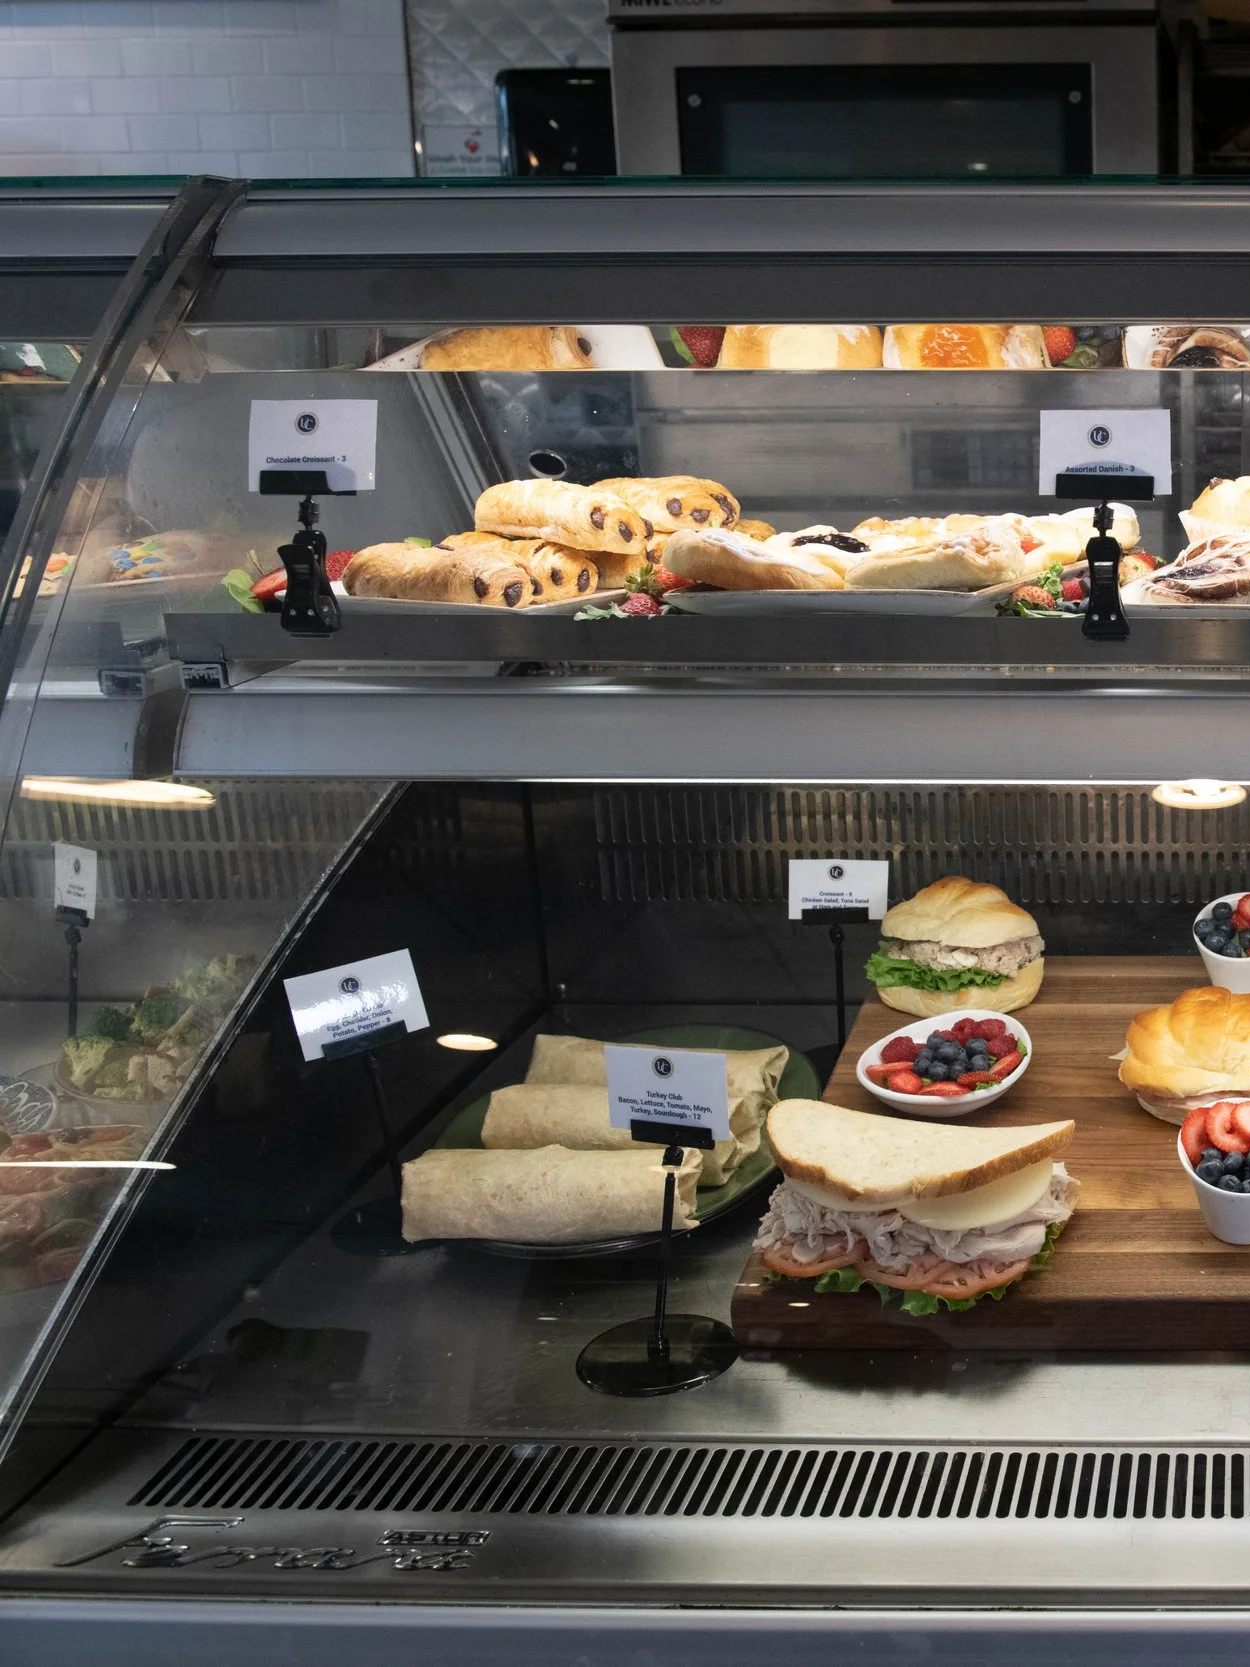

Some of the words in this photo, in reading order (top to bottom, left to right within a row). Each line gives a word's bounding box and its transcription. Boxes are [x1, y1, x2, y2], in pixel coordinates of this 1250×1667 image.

[326, 1024, 341, 1032] Egg,
[372, 1008, 393, 1019] Onion,
[332, 1027, 357, 1039] Potato,
[358, 1020, 381, 1032] Pepper
[646, 1091, 667, 1100] Turkey
[618, 1096, 639, 1105] Bacon,
[640, 1099, 665, 1108] Lettuce,
[667, 1102, 693, 1112] Tomato,
[693, 1104, 713, 1114] Mayo,
[630, 1106, 653, 1116] Turkey,
[654, 1110, 688, 1119] Sourdough
